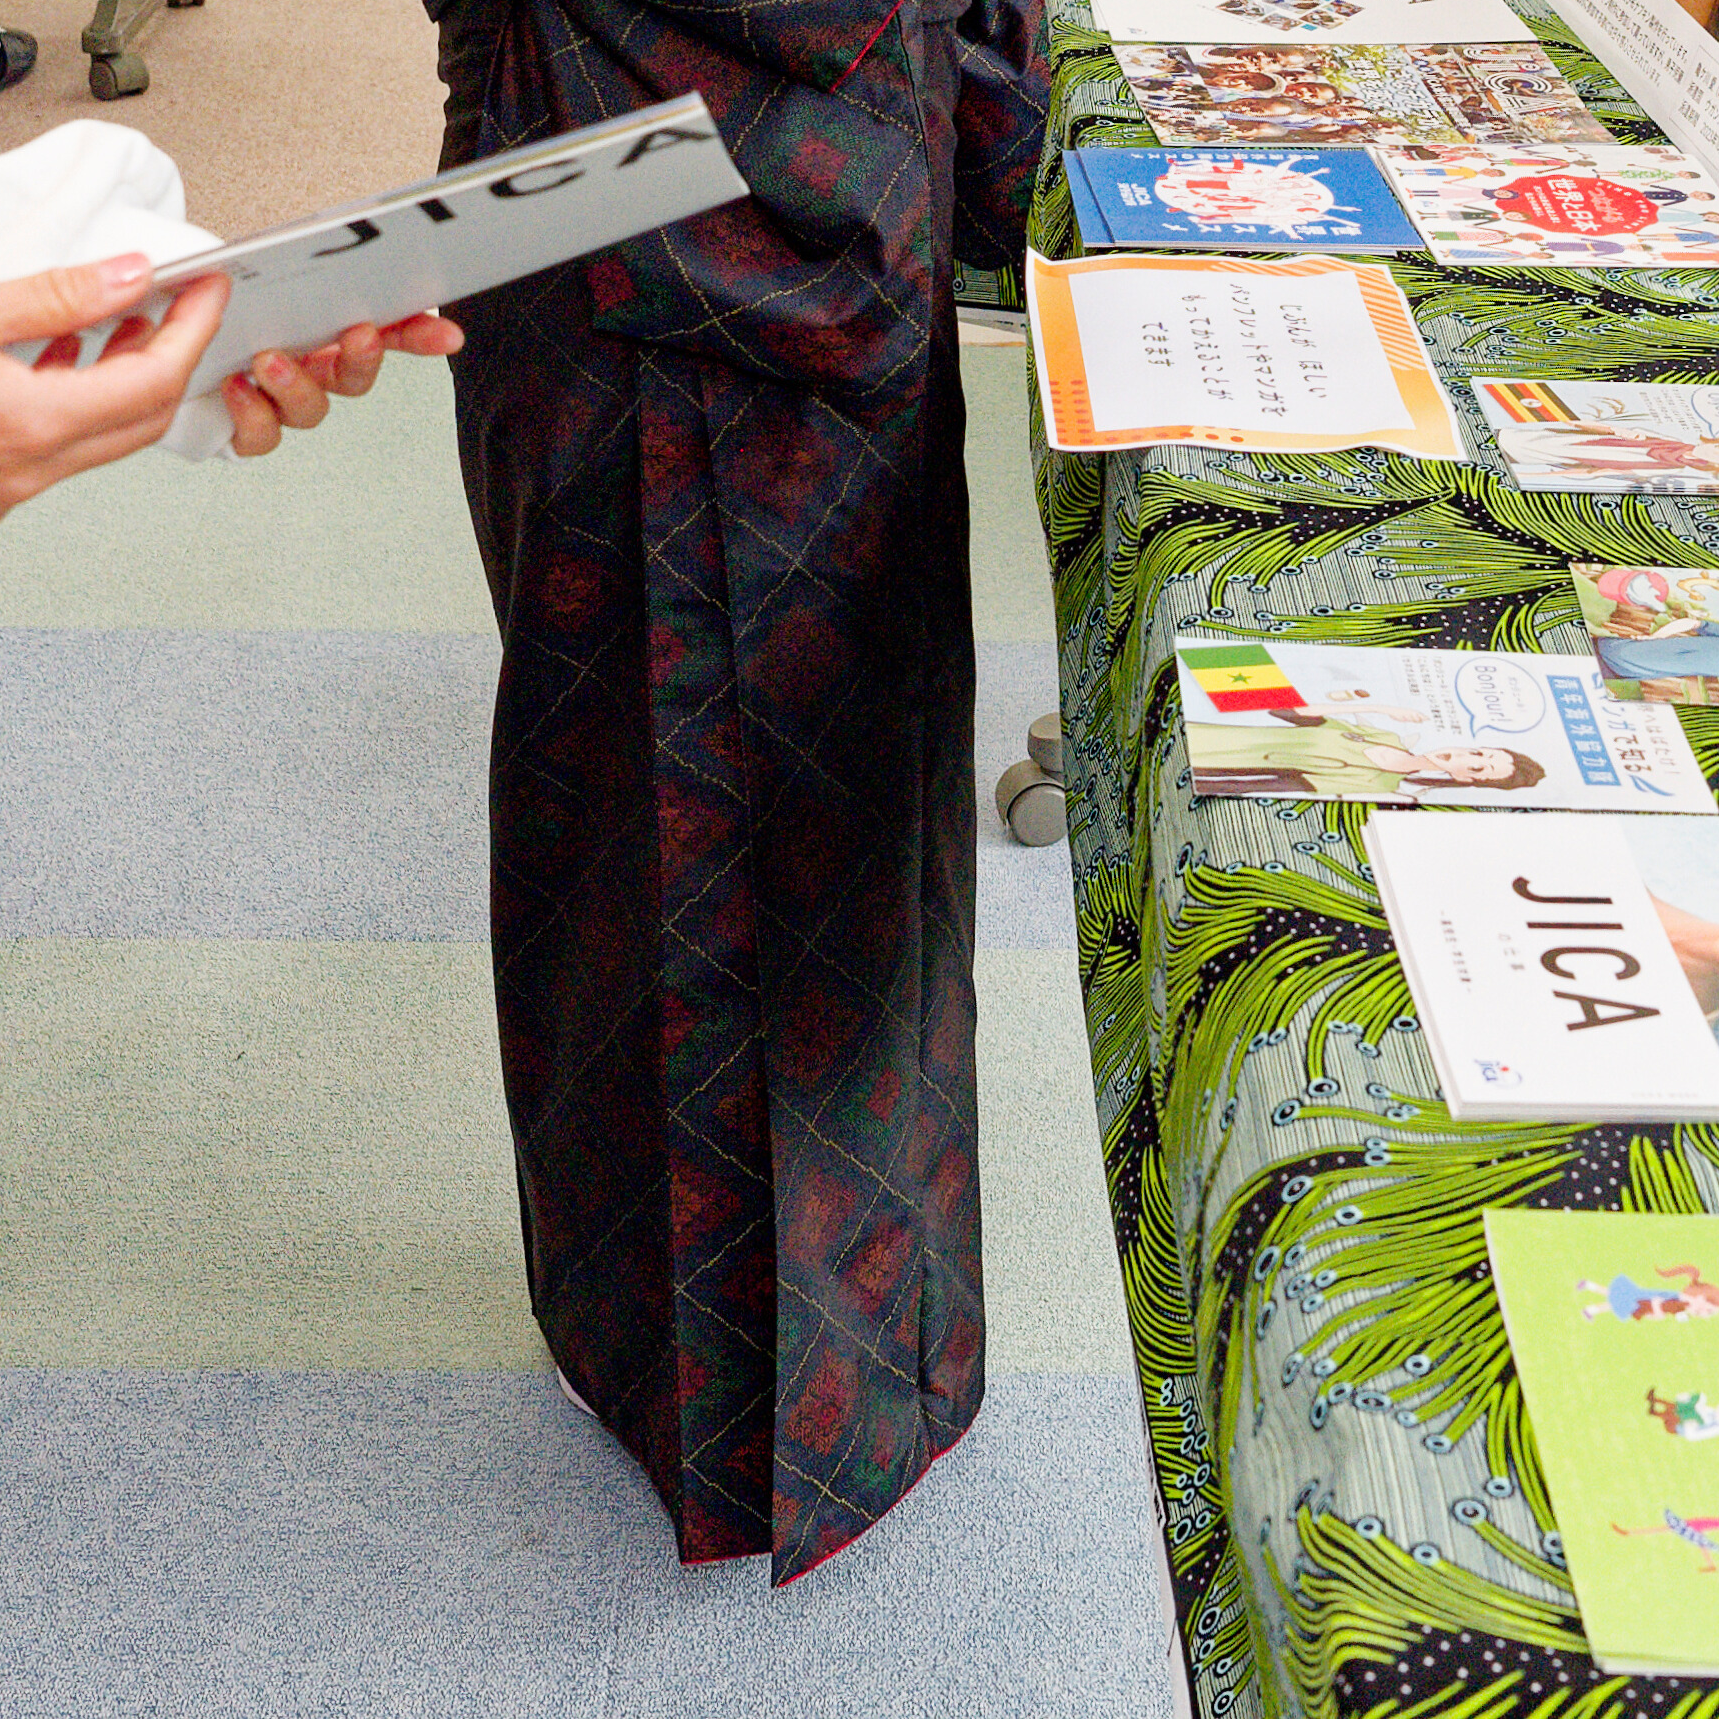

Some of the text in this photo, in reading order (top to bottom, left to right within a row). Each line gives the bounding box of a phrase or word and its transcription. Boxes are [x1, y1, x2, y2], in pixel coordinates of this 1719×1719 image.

[311, 125, 720, 258] JICA
[1547, 177, 1603, 232] 世界と日本
[1139, 320, 1182, 366] できます
[1177, 293, 1241, 399] もってかえることが
[1228, 283, 1292, 414] パンフレットやマンガを
[1276, 302, 1337, 397] じぶんが ほしい
[1473, 664, 1513, 725] Bonjour!
[1552, 676, 1616, 785] 青年海外協力隊
[1640, 702, 1681, 775] 界へはばたけ！
[1512, 875, 1662, 1033] JICA
